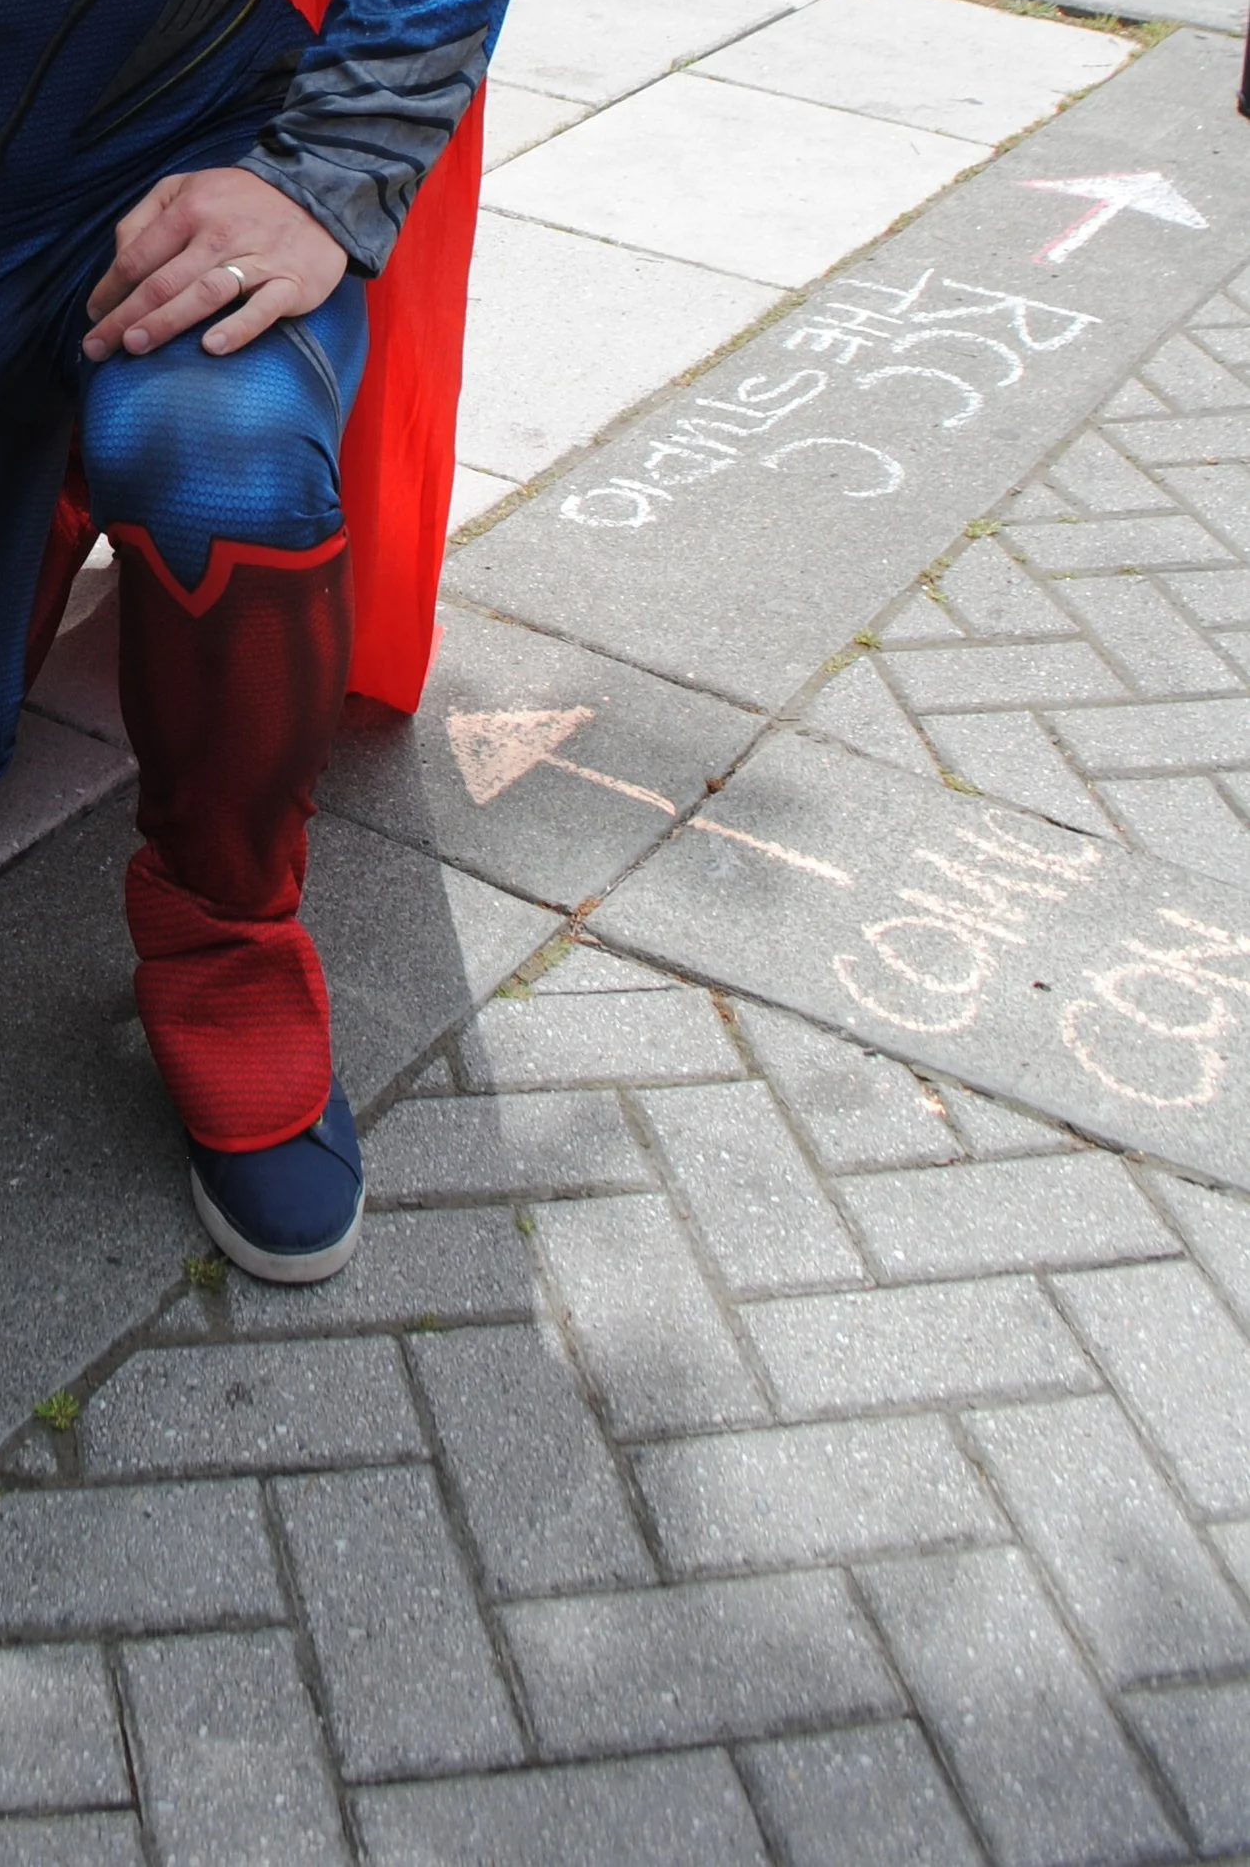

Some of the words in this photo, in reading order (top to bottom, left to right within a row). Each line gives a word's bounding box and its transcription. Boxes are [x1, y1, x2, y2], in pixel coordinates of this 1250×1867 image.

[782, 268, 937, 365] THE
[560, 369, 830, 529] STUDIO
[832, 808, 1104, 1034] COMIC
[1062, 906, 1250, 1110] CON
